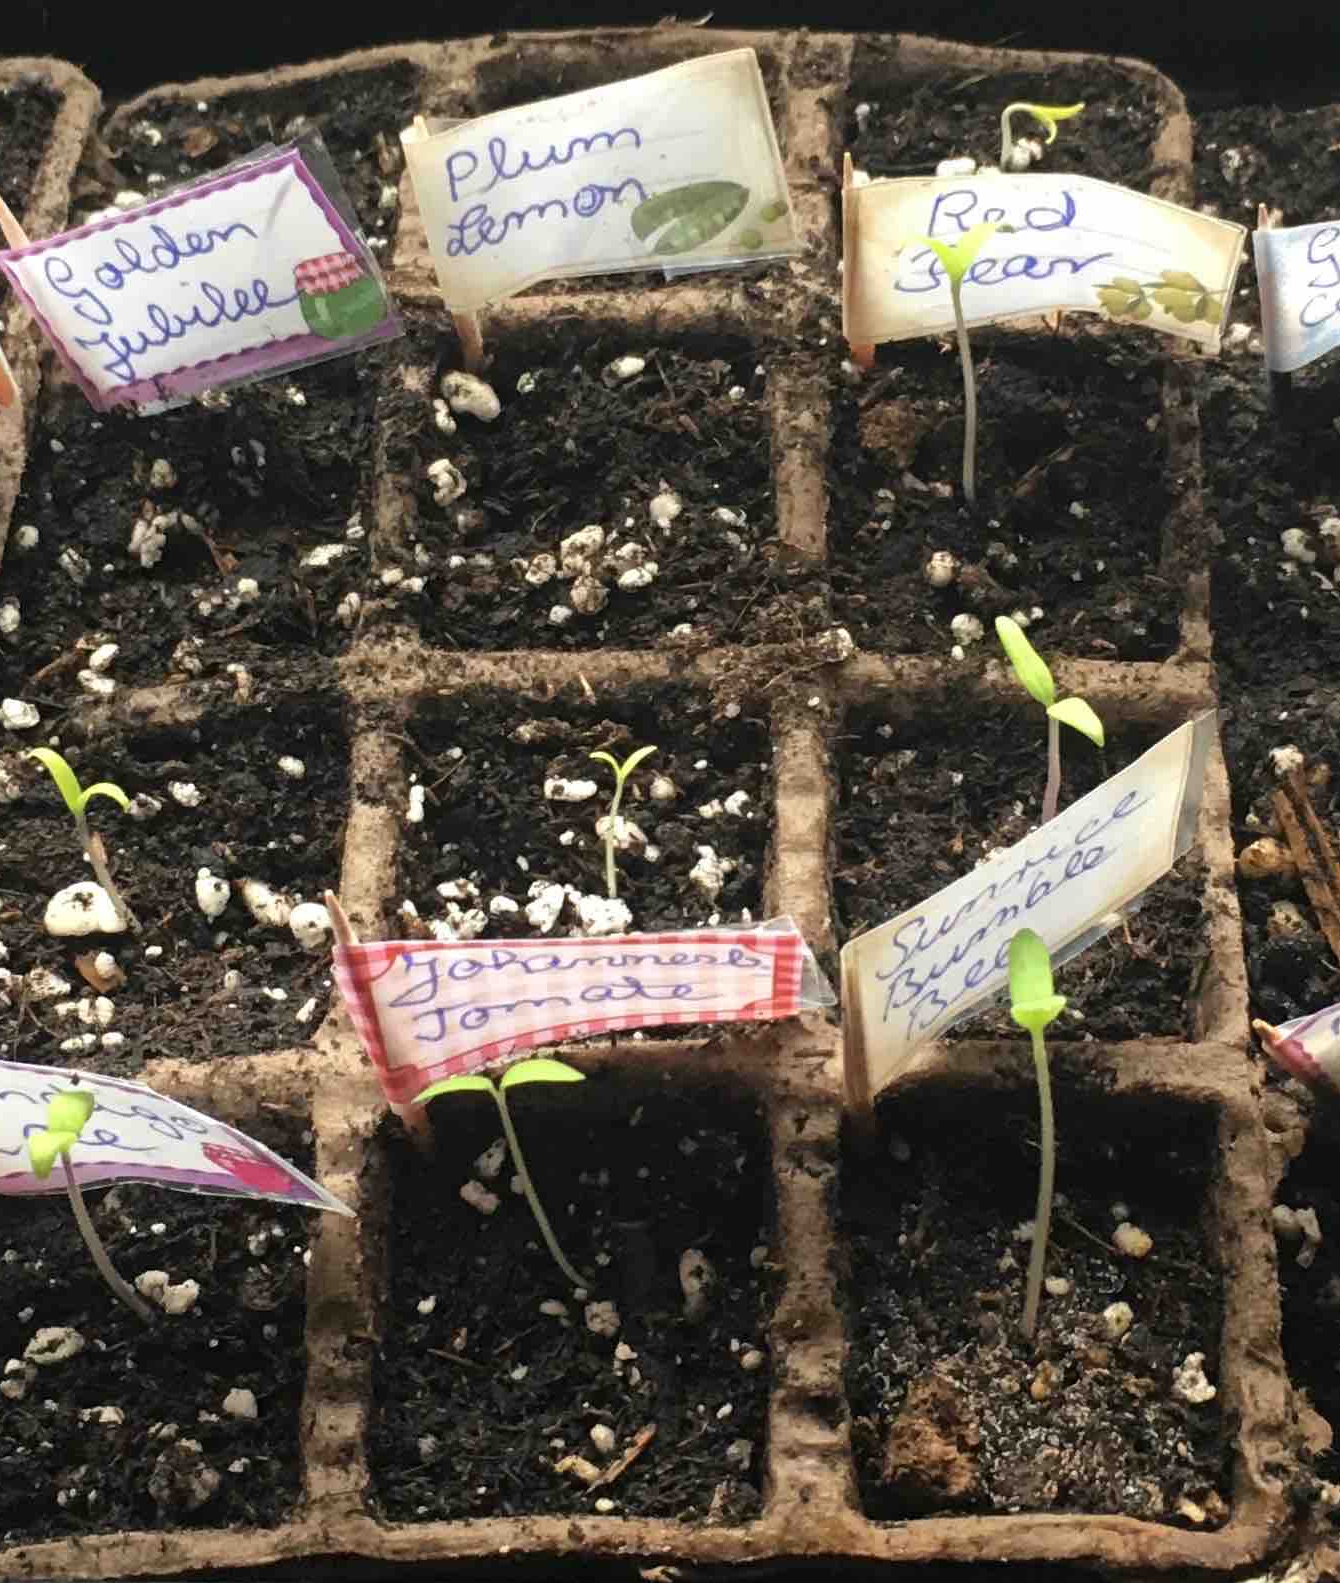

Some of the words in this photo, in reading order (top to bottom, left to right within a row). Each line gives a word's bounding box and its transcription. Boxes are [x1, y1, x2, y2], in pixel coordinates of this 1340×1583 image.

[446, 128, 641, 202] Plum
[447, 177, 649, 256] Lemon
[928, 190, 1076, 237] Red
[45, 216, 256, 325] Golden
[76, 279, 300, 381] Jubilee
[413, 976, 715, 1042] Tomate
